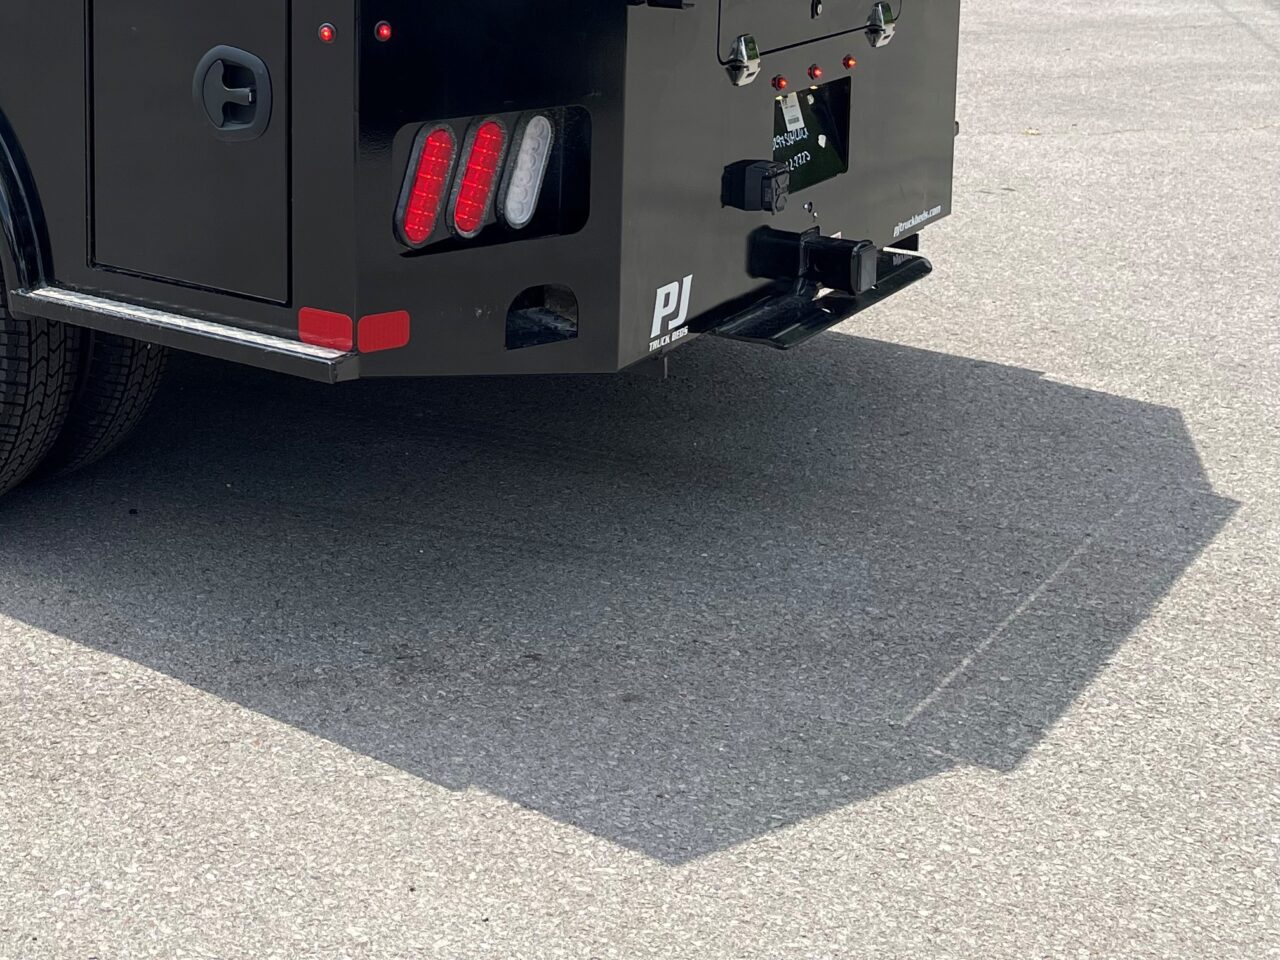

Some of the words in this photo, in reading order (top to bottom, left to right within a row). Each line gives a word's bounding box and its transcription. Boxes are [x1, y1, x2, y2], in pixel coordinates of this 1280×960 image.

[650, 274, 693, 339] PJ
[648, 334, 671, 352] TRUCK
[671, 325, 689, 342] BEDS
